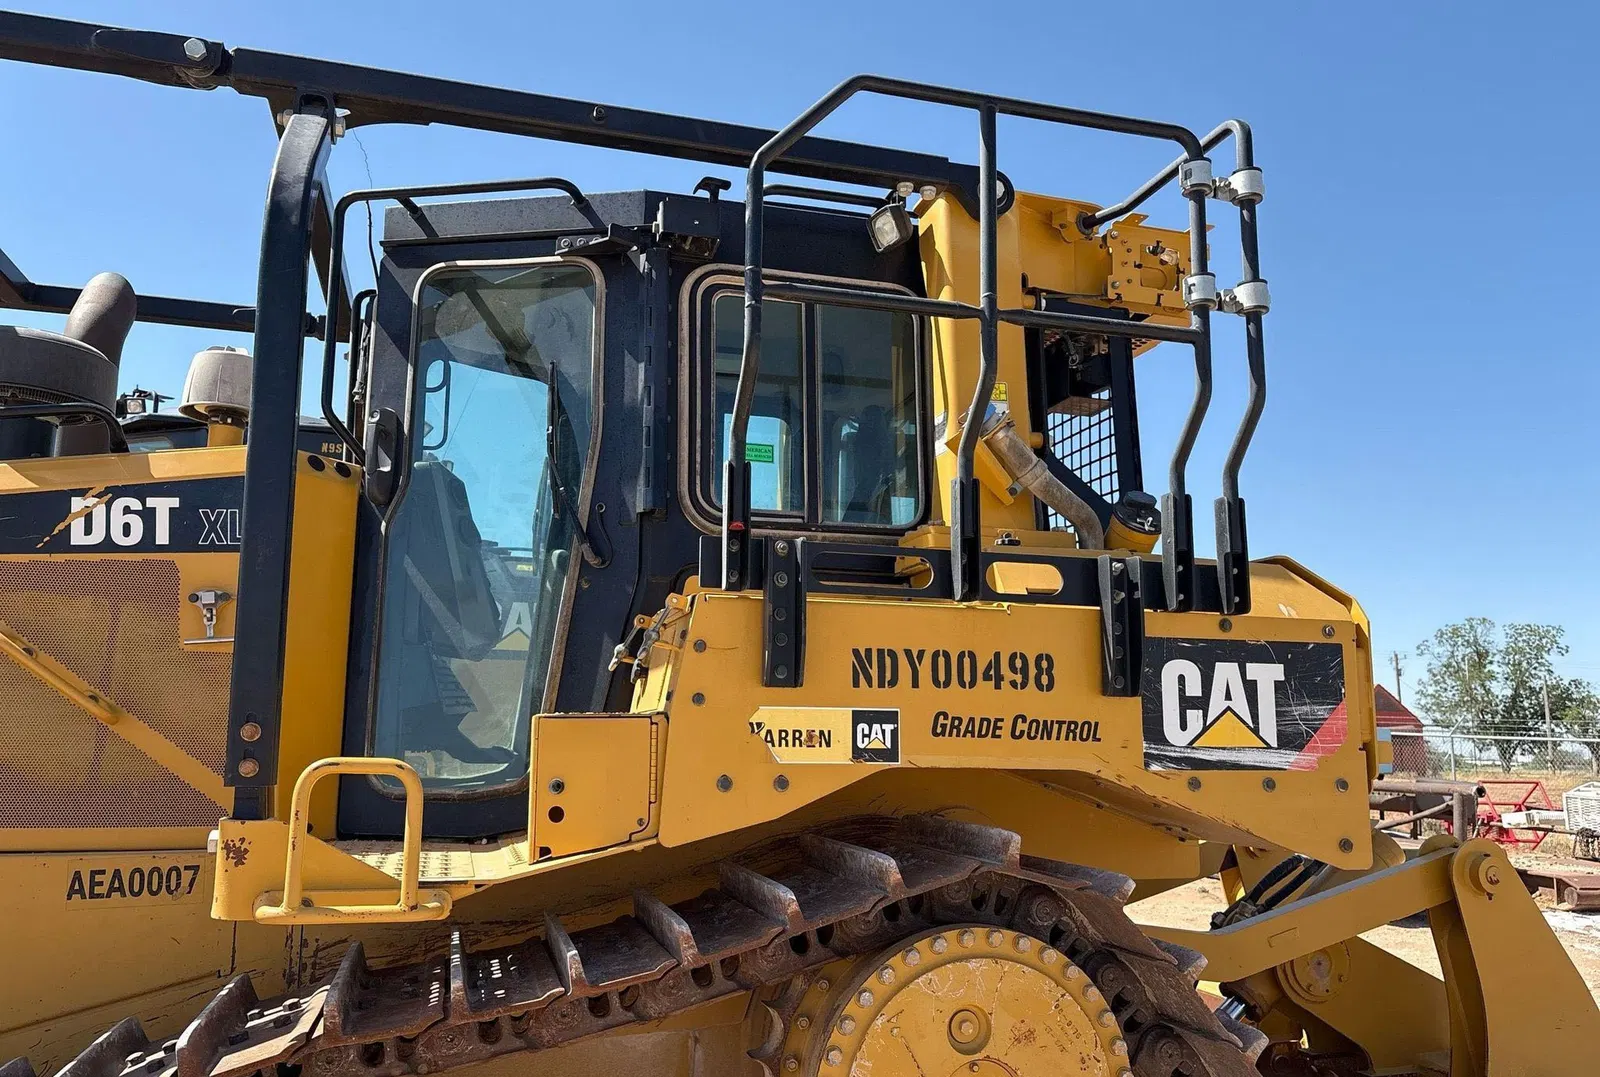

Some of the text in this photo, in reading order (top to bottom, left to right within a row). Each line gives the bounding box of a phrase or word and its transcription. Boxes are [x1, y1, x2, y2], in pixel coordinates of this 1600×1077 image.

[746, 446, 772, 454] MERICAN
[70, 497, 242, 546] D6T XL
[851, 648, 1056, 693] NDY00498
[1161, 659, 1285, 748] CAT
[856, 722, 896, 749] CAT
[931, 711, 1102, 743] GRADE CONTROL
[66, 864, 201, 901] AEA0007
